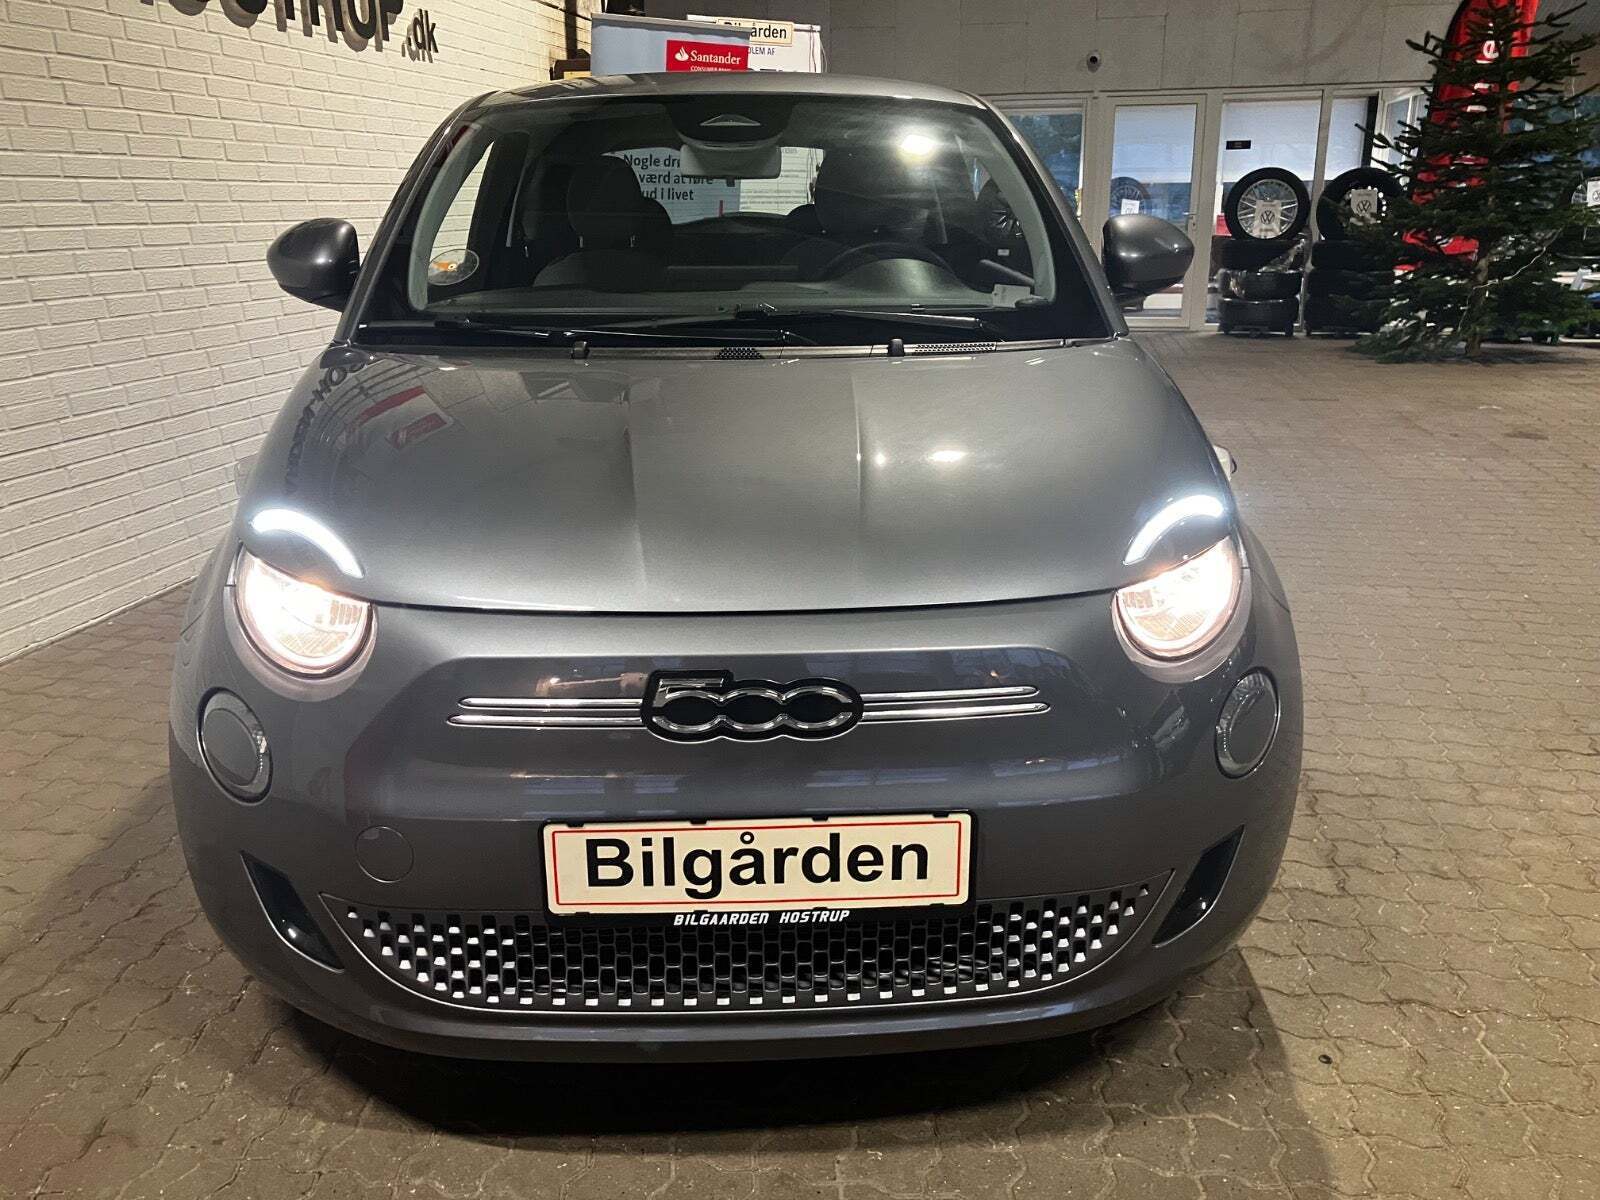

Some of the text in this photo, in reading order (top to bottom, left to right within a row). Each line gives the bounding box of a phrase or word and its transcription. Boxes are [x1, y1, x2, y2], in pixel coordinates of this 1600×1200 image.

[690, 49, 741, 65] Santander
[624, 154, 660, 169] Nogle
[639, 171, 670, 184] værd
[668, 187, 694, 200] livet
[650, 676, 854, 734] 500
[585, 831, 929, 899] Bilgården
[673, 910, 850, 926] BILGAARDEN HOSTRUP
